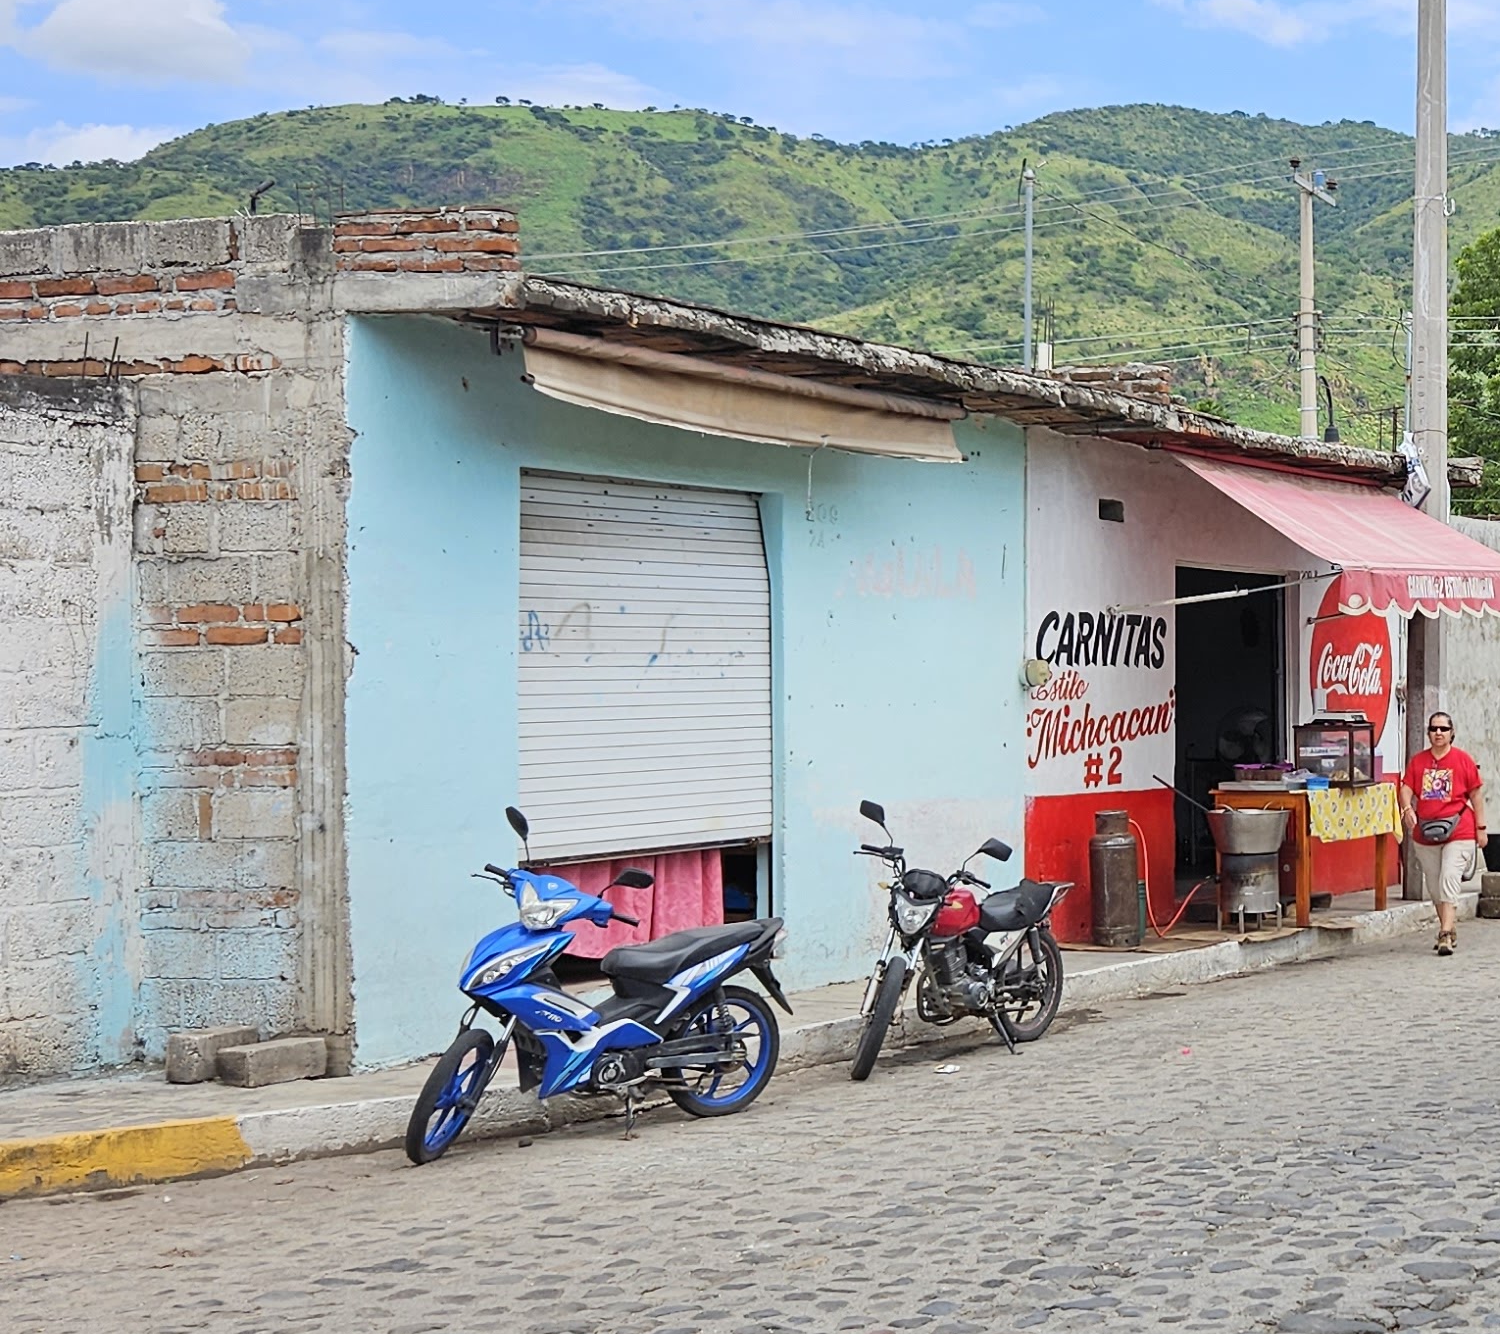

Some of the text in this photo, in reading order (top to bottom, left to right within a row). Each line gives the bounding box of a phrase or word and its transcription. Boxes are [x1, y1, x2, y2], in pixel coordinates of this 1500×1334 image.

[1036, 610, 1167, 669] CARNITAS
[1317, 642, 1383, 696] Coca-Cola
[1083, 746, 1123, 788] #2
